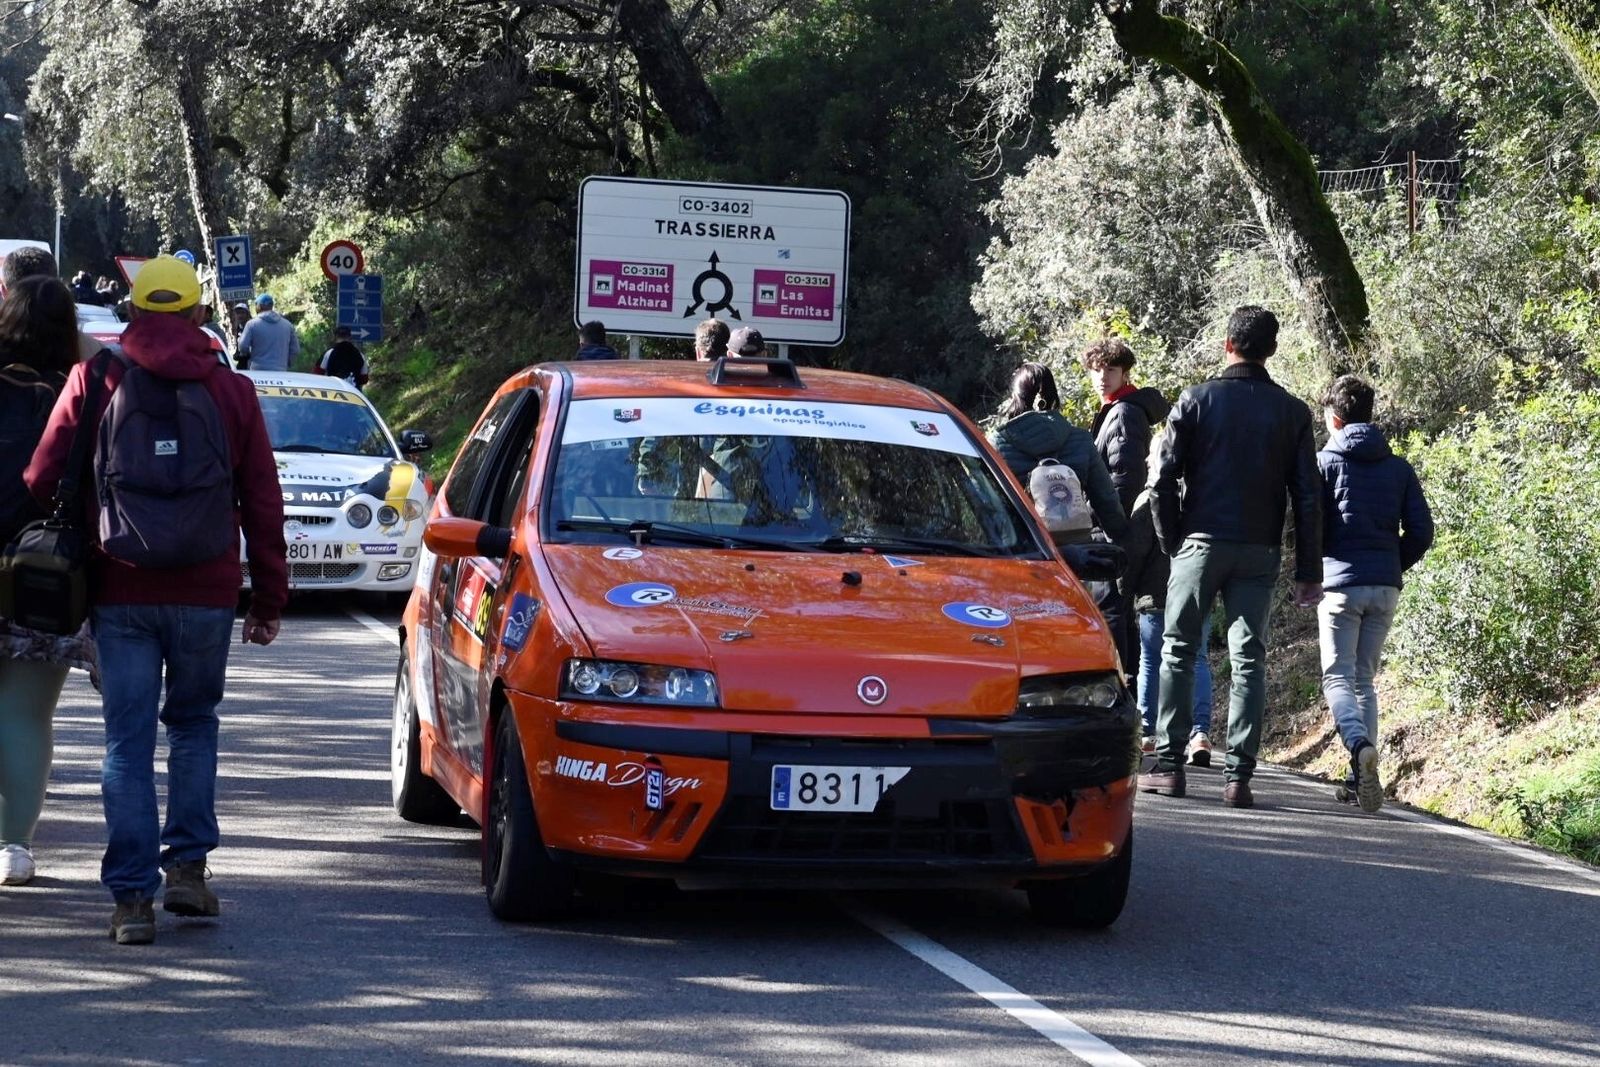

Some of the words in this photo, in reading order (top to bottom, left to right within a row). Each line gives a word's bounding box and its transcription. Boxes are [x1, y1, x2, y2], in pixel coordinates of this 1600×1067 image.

[683, 200, 749, 214] CO-3402
[655, 220, 775, 240] TRASSIERRA
[330, 255, 354, 269] 40
[623, 266, 666, 276] CO-3314
[617, 280, 670, 293] Madinat
[786, 276, 828, 285] CO-3314
[617, 295, 668, 308] Alzhara
[781, 289, 804, 301] Las
[780, 304, 830, 317] Ermitas
[278, 388, 349, 401] MATA
[693, 402, 825, 420] Esquinas
[773, 417, 811, 426] apoyo
[301, 488, 356, 502] MATA
[323, 544, 343, 559] AW
[555, 755, 608, 782] HINGA
[798, 772, 884, 805] 8311
[778, 792, 786, 802] E
